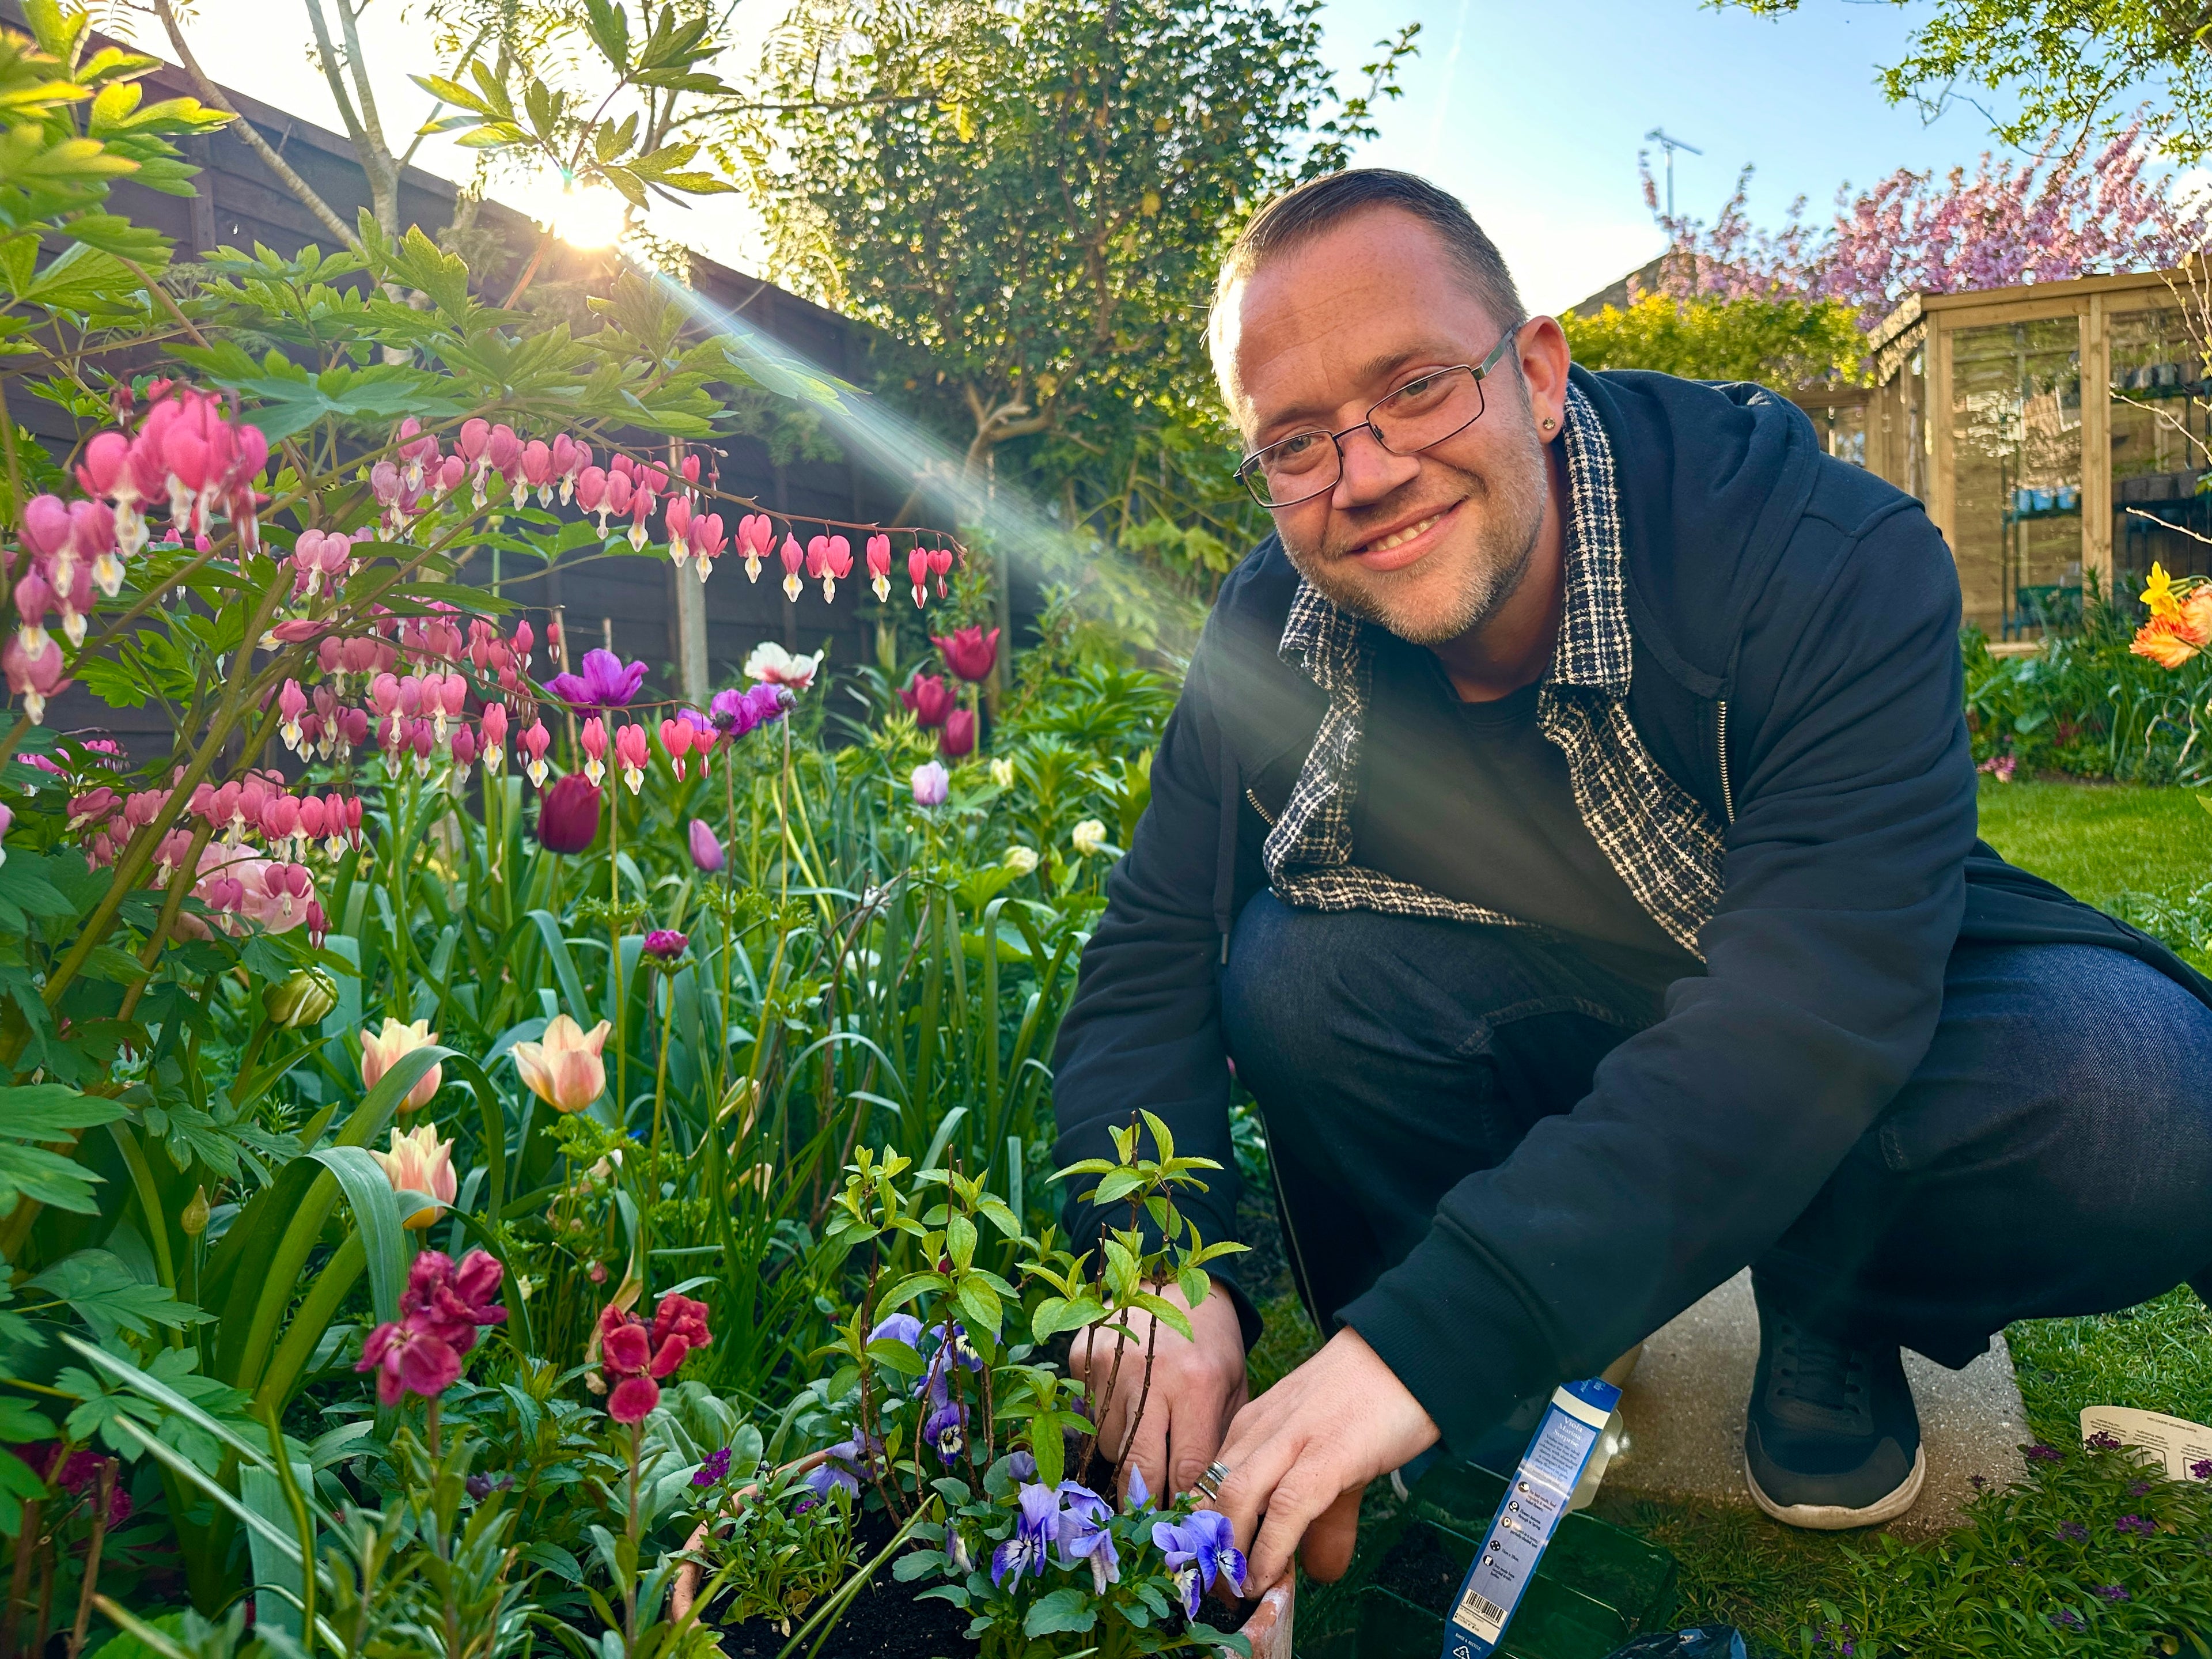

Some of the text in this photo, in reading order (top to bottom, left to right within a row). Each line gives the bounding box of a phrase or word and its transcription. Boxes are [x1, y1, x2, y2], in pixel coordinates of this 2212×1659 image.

[1558, 1423, 1582, 1441] Marina
[1563, 1416, 1584, 1433] Viola
[1552, 1429, 1580, 1448] Surprise
[1518, 1514, 1528, 1522] through
[1520, 1509, 1530, 1517] Flowers
